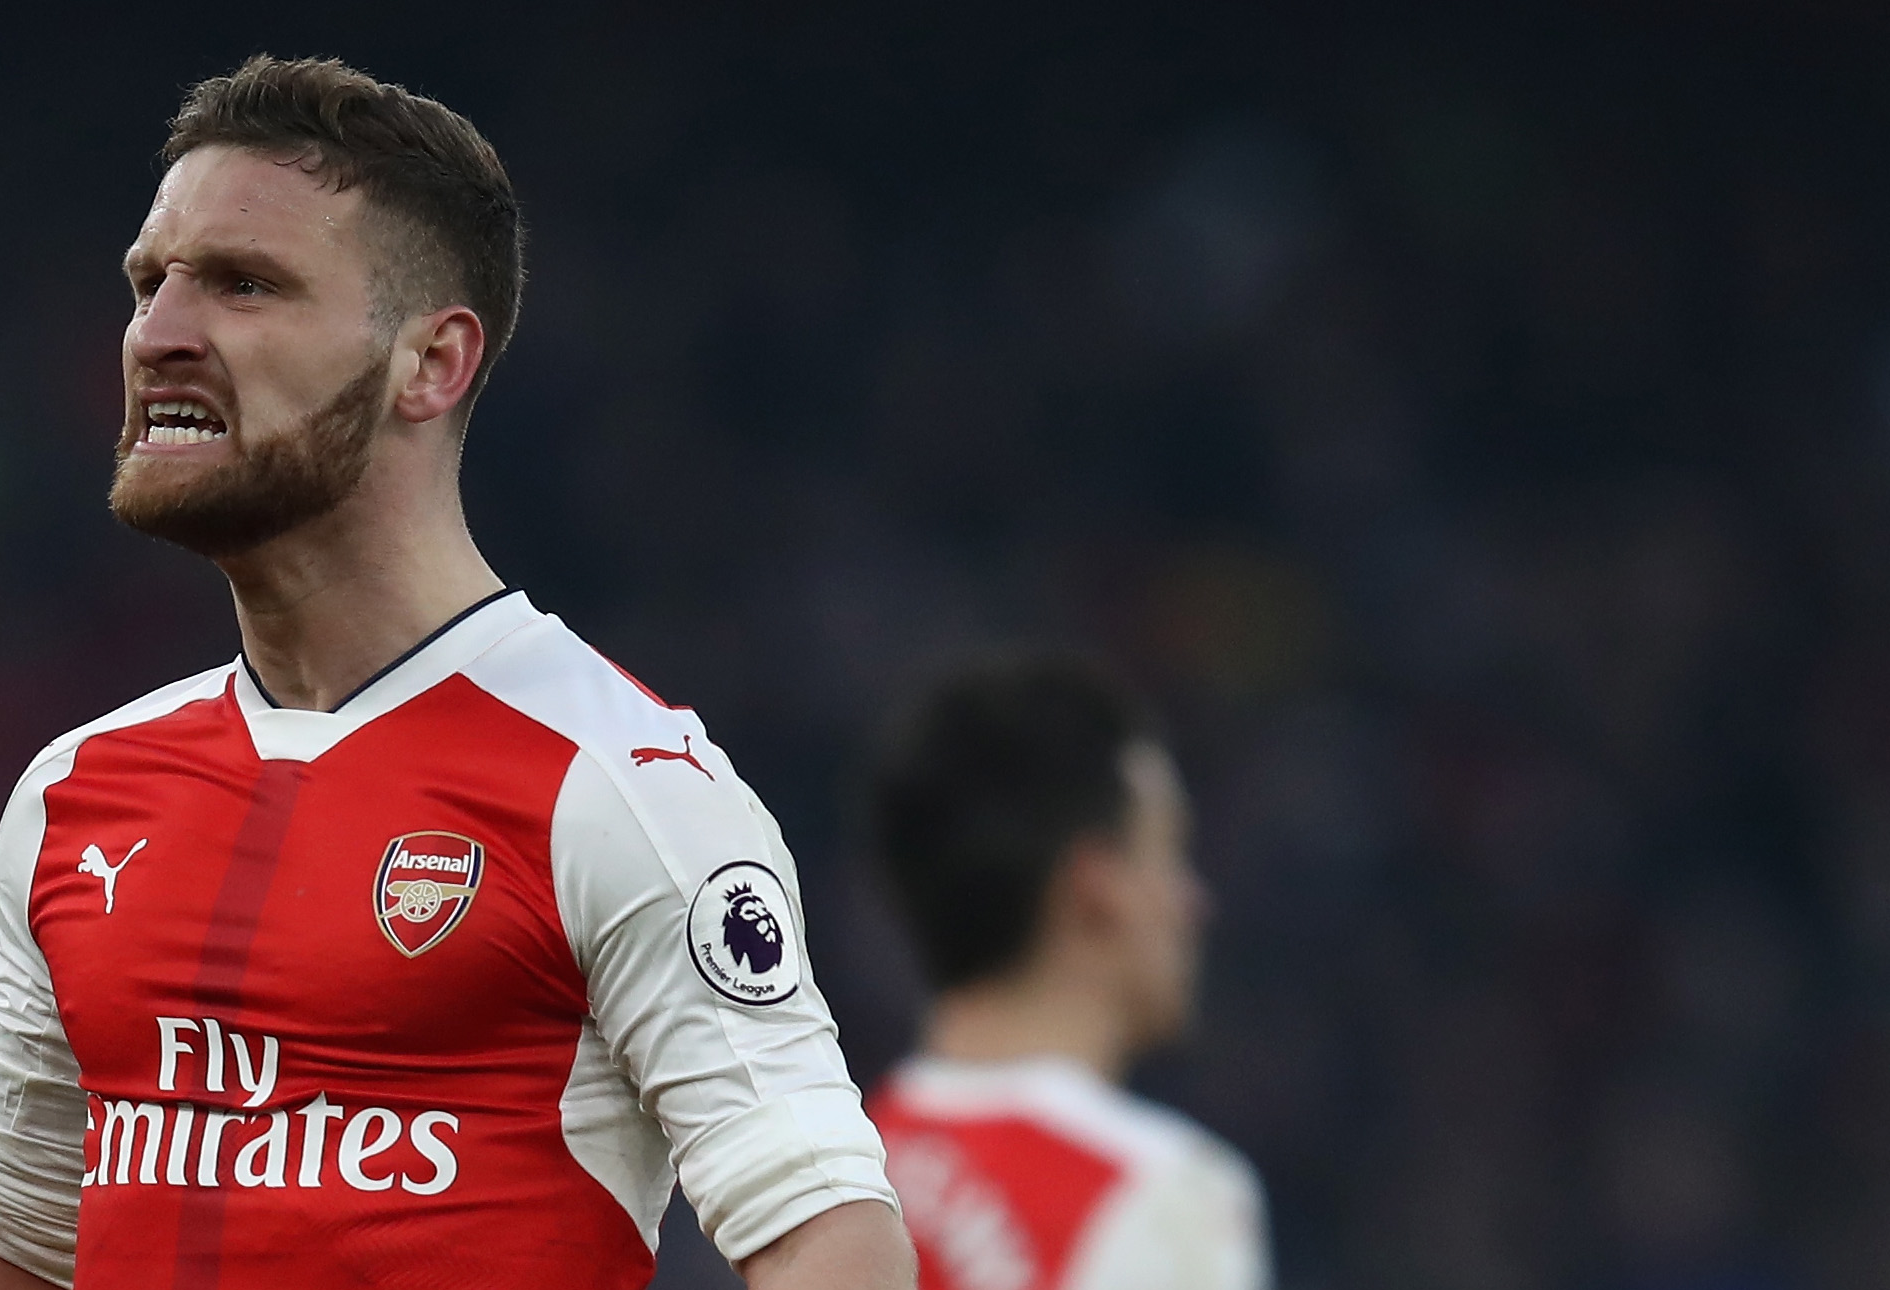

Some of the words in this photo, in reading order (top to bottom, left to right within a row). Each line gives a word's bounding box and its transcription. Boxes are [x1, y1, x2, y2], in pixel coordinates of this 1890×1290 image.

[392, 849, 470, 874] Arsenal
[700, 942, 731, 984] Premier
[732, 977, 776, 997] League
[156, 1016, 279, 1107] Fly
